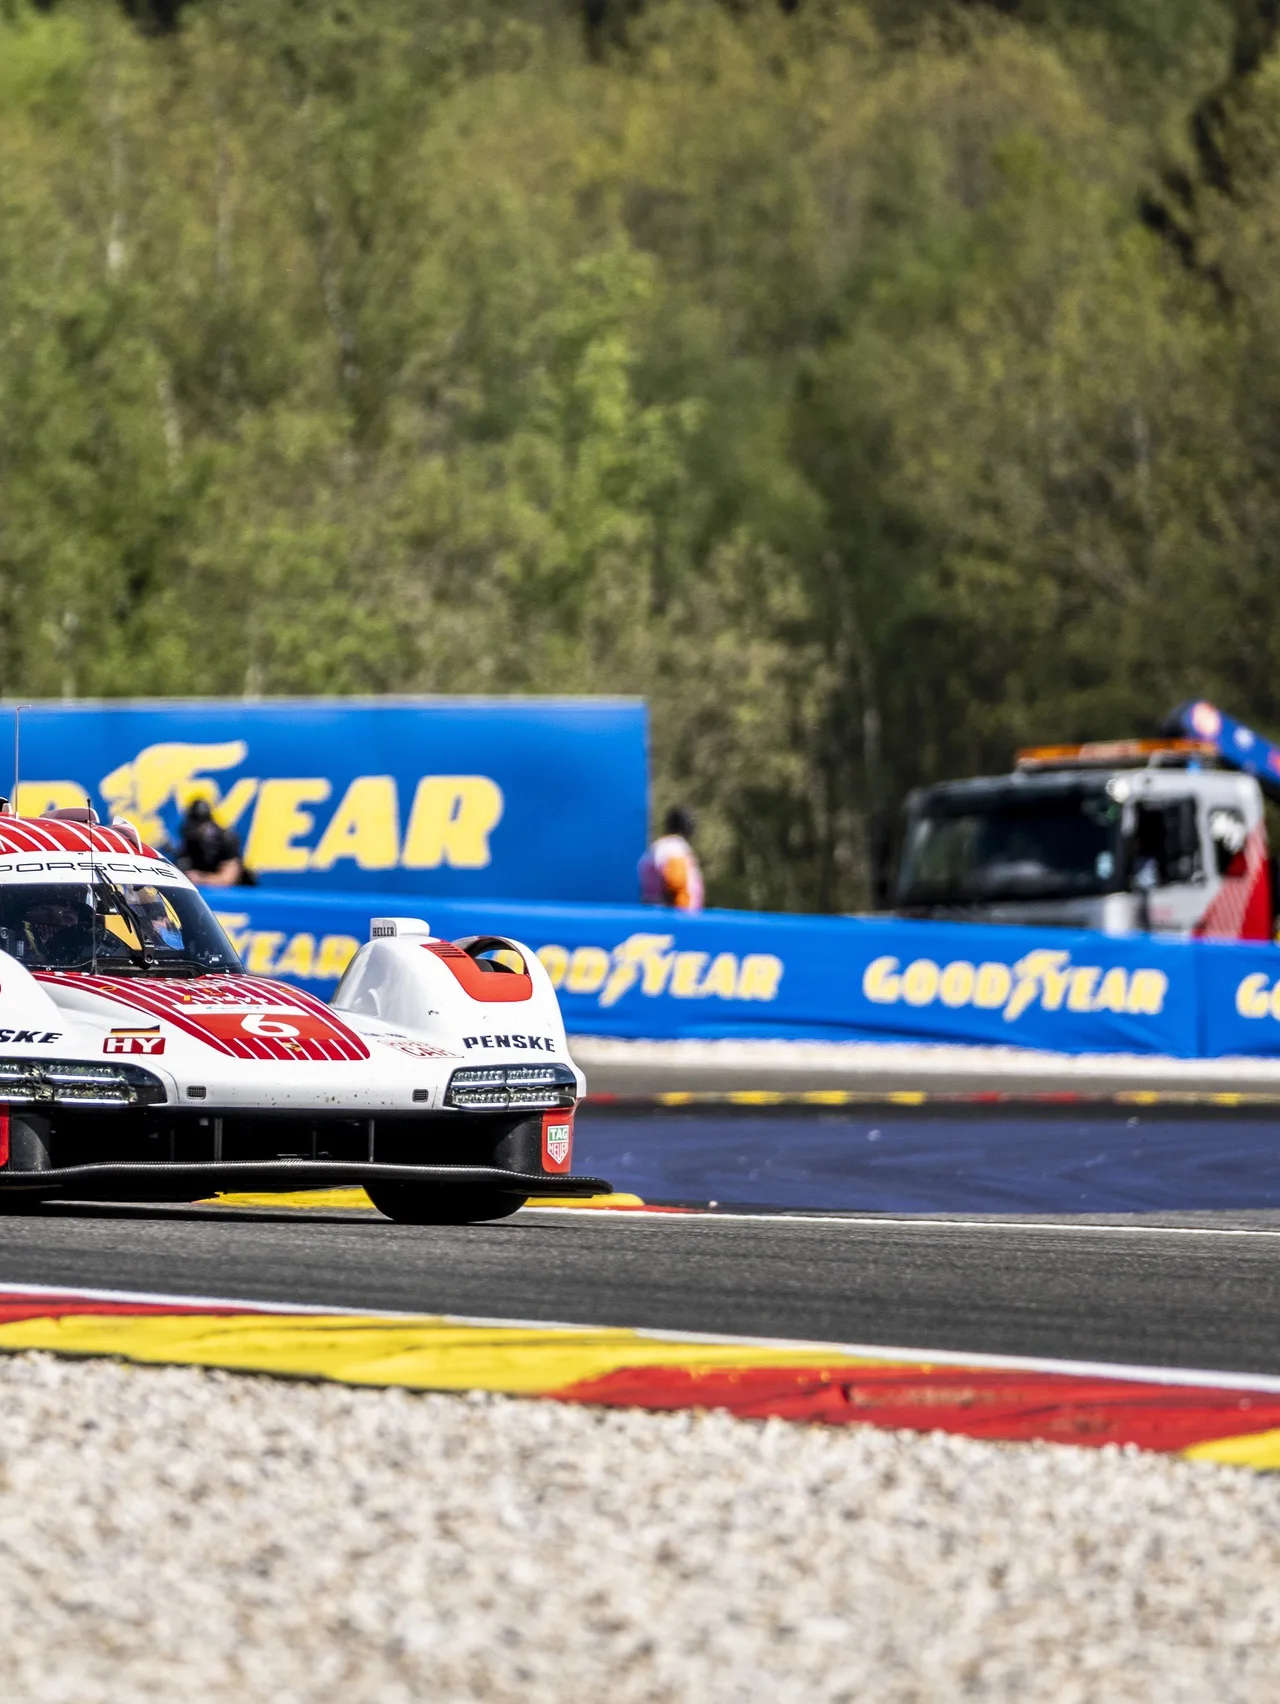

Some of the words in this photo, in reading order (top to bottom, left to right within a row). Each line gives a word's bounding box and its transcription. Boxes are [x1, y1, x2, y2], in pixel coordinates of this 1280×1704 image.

[372, 926, 395, 937] HELLER
[863, 955, 1169, 1015] GOODYEAR
[240, 1014, 301, 1037] 6
[106, 1039, 161, 1053] HY
[462, 1034, 556, 1053] PENSKE
[549, 1127, 568, 1141] TAG
